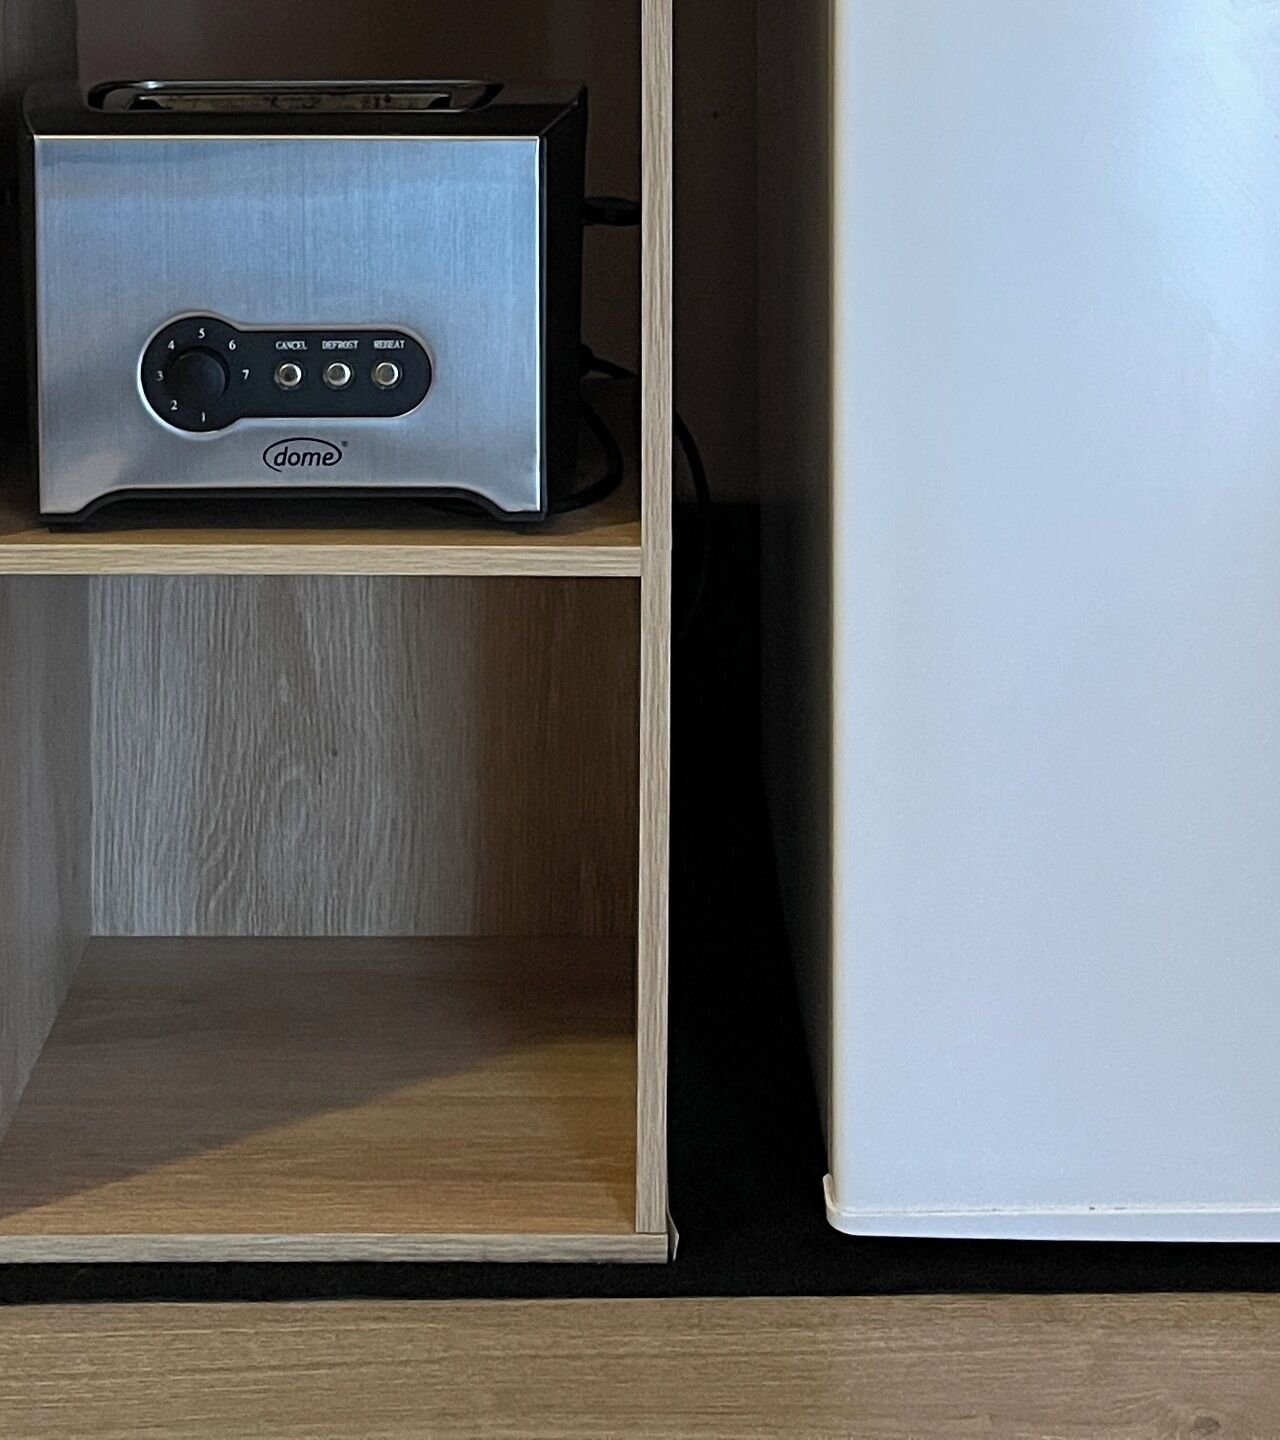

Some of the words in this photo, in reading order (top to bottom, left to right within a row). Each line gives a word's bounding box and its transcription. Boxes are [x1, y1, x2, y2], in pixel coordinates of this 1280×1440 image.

[198, 328, 206, 339] 5
[167, 340, 175, 350] 4
[228, 340, 237, 350] 6
[275, 340, 308, 350] CANCEL
[322, 340, 359, 349] DEFROST
[156, 370, 164, 381] 3
[242, 369, 250, 380] 7
[170, 400, 178, 410] 2
[201, 412, 206, 422] 1
[273, 446, 334, 466] dome
